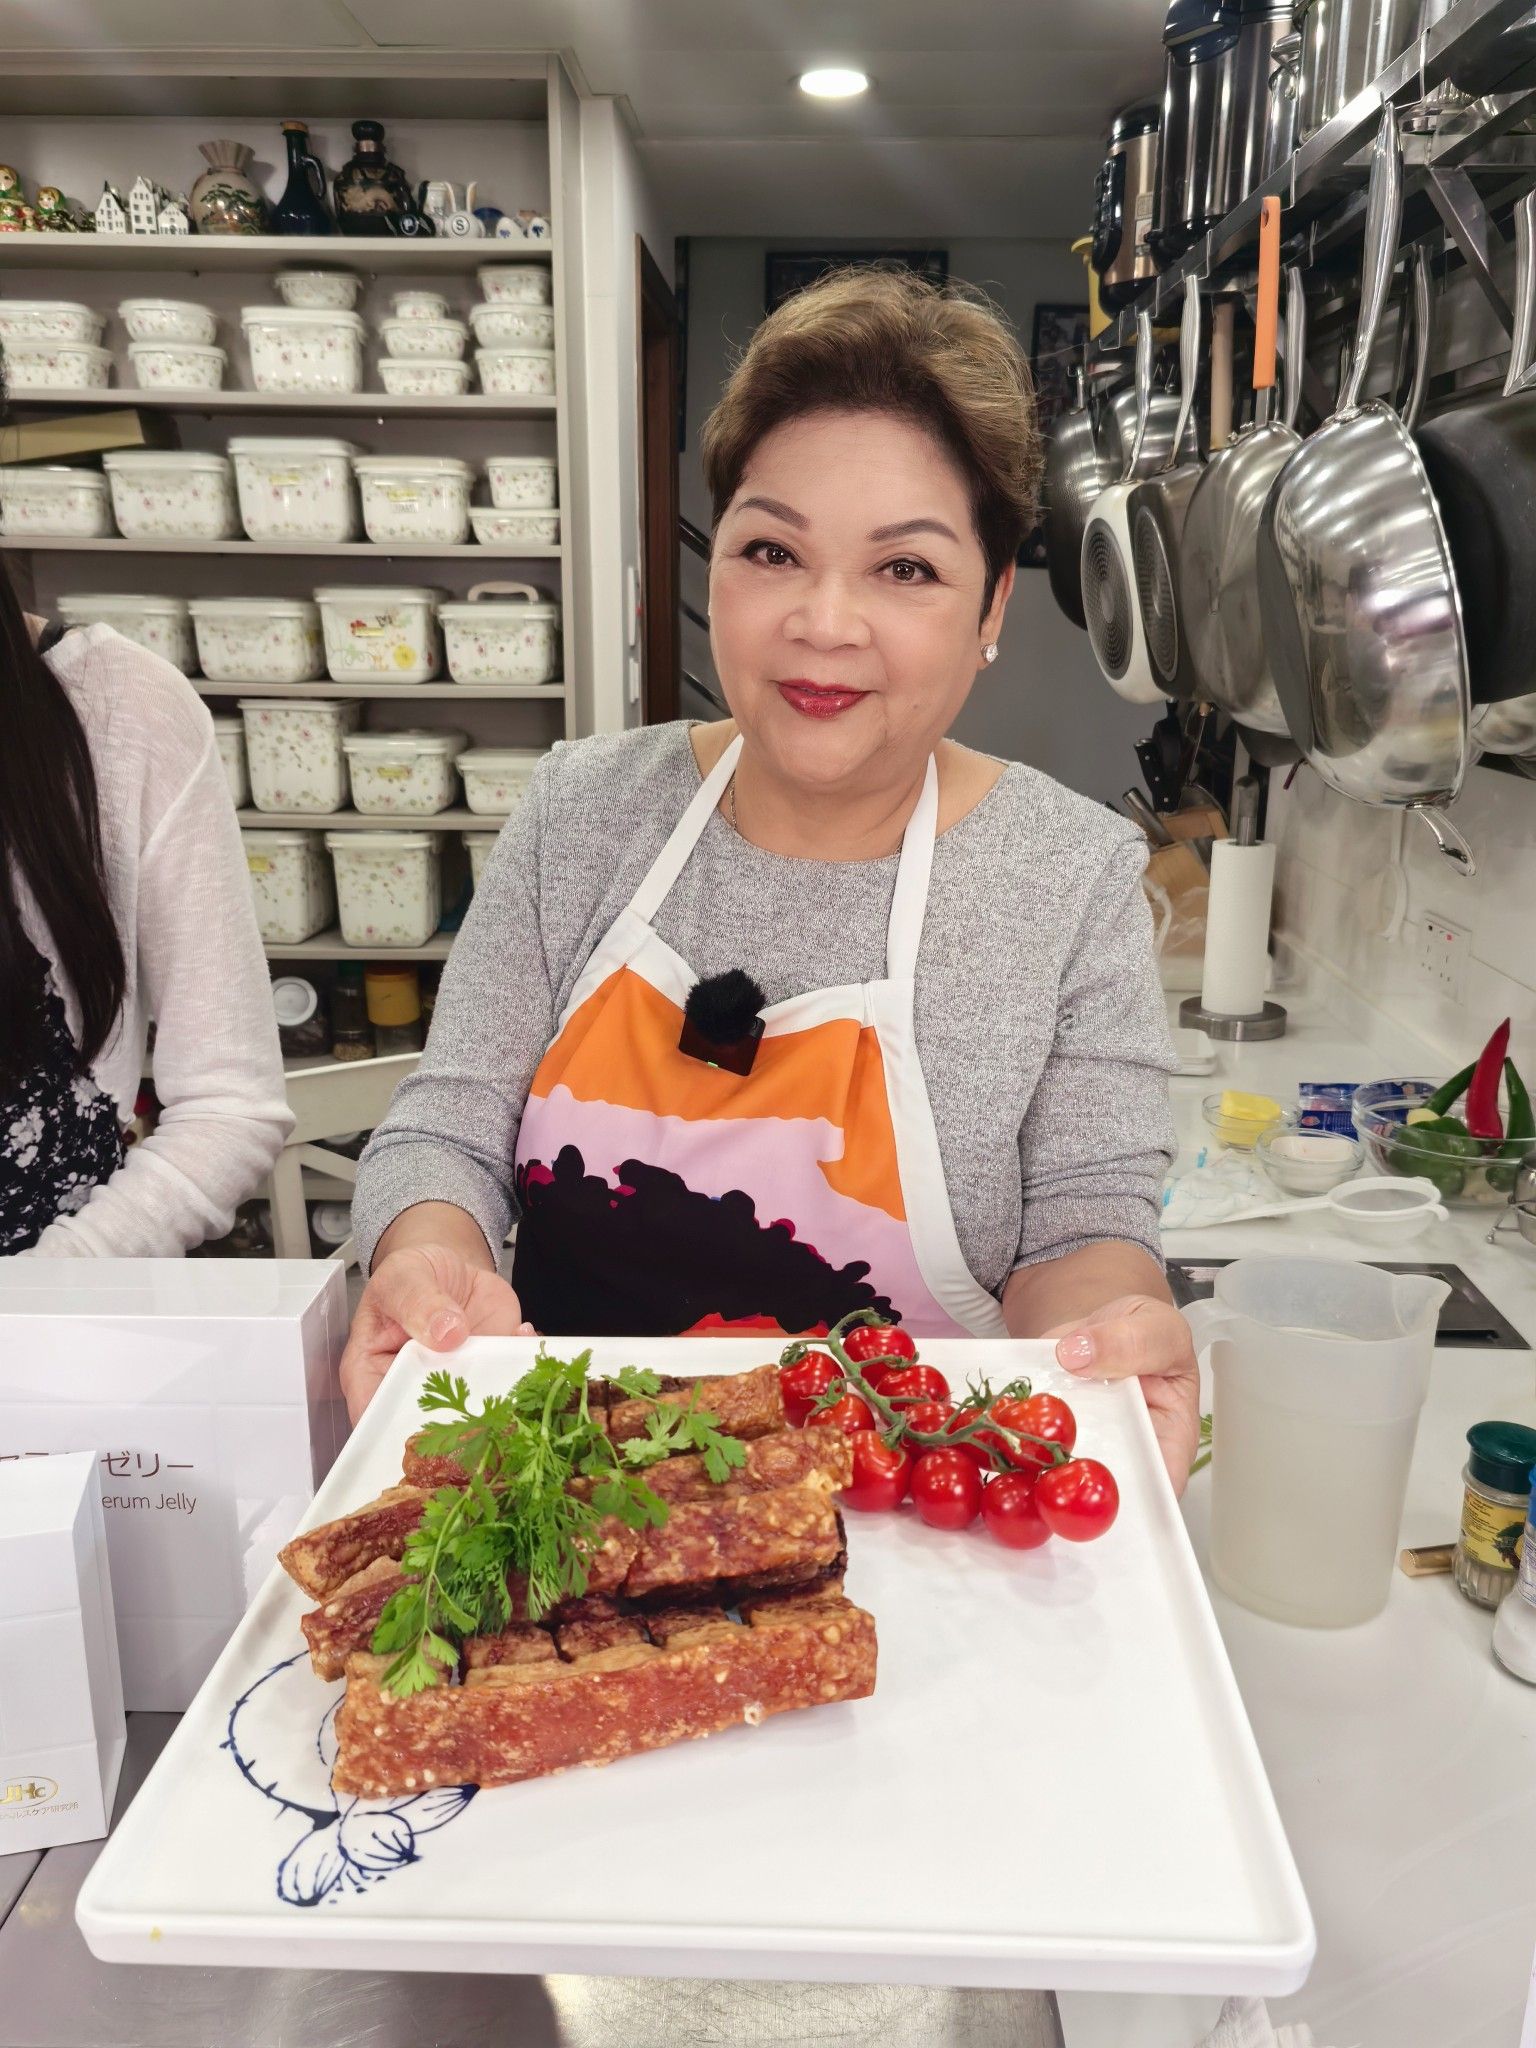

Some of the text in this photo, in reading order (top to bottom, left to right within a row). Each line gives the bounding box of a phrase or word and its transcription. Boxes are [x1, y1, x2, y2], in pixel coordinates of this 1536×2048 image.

[100, 1450, 194, 1478] ゼリー
[101, 1492, 197, 1515] erum Jelly
